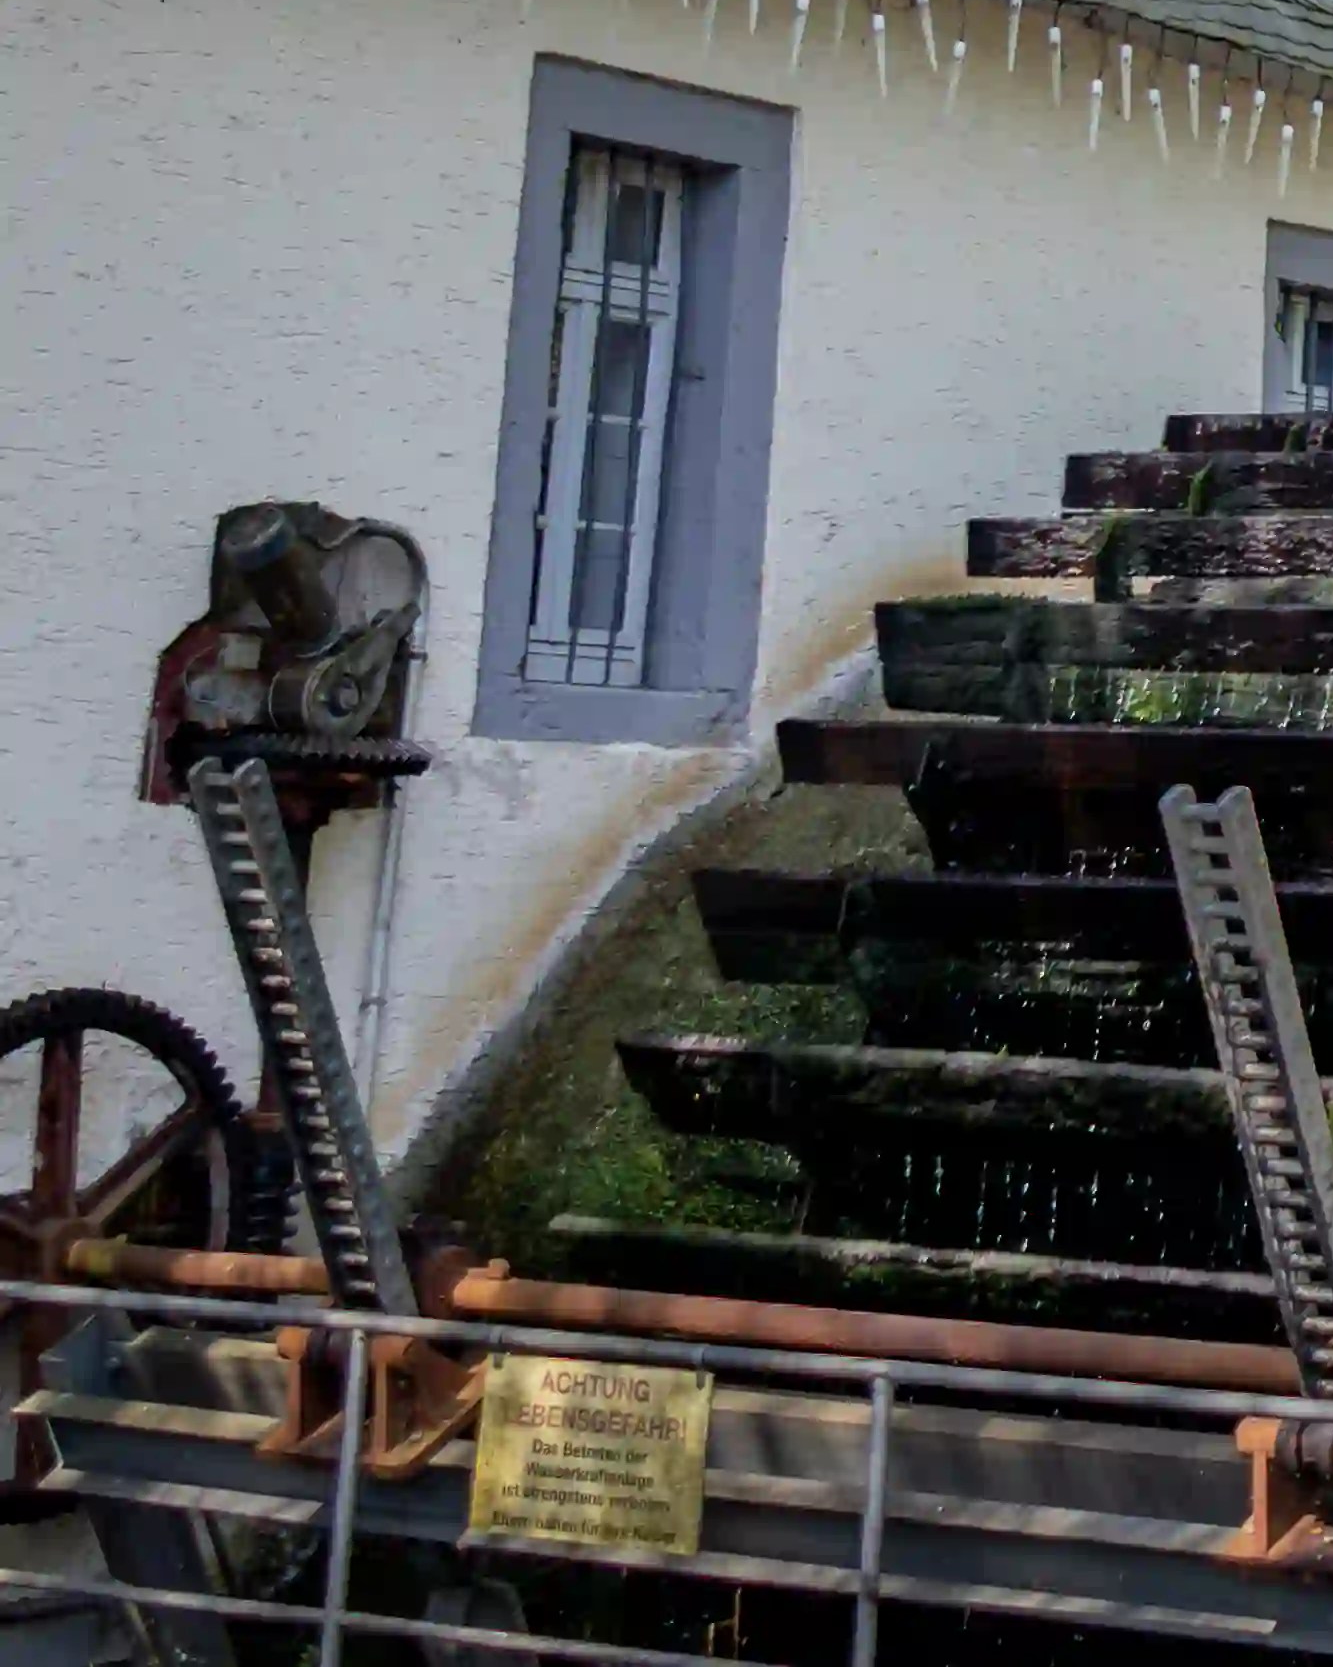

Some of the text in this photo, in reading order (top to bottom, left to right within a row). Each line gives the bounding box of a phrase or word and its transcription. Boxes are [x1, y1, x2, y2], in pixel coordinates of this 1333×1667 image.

[541, 1369, 650, 1404] ACHTUNG
[504, 1401, 686, 1443] LEBENSGEFAHR!
[532, 1438, 559, 1457] Das
[625, 1448, 648, 1464] der
[502, 1482, 520, 1498] ist
